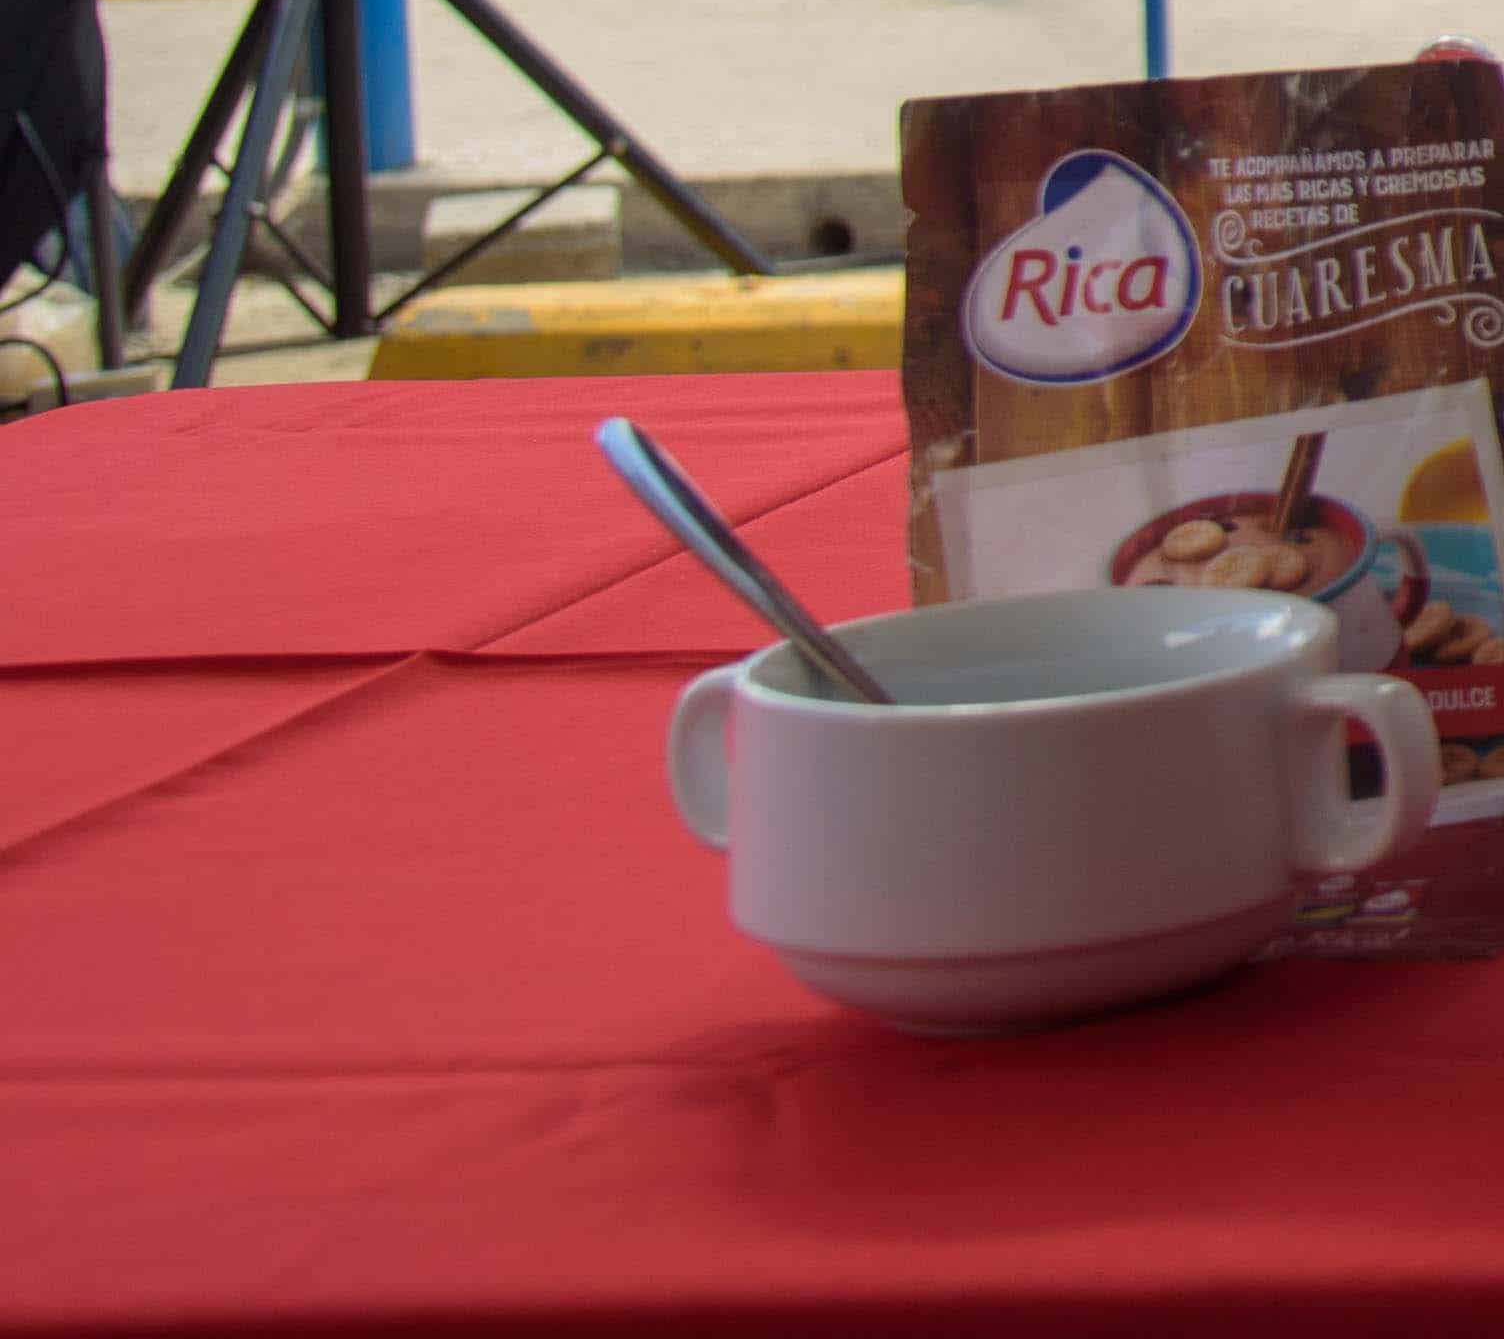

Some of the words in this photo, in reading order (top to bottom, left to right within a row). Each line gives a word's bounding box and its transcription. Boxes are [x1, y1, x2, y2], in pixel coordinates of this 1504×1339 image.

[1209, 158, 1231, 178] TE
[1235, 146, 1367, 177] ACOMPAÑAMOS
[1370, 148, 1386, 169] A
[1391, 138, 1495, 167] PREPARAR
[1227, 183, 1252, 205] LAS
[1300, 176, 1354, 200] RICAS
[1355, 174, 1371, 197] Y
[1374, 166, 1486, 195] CREMOSAS
[1252, 204, 1330, 229] RECETAS
[1335, 203, 1360, 225] DE
[1001, 245, 1169, 326] Rica
[1221, 221, 1495, 333] CUARESMA
[1428, 684, 1497, 711] DULCE
